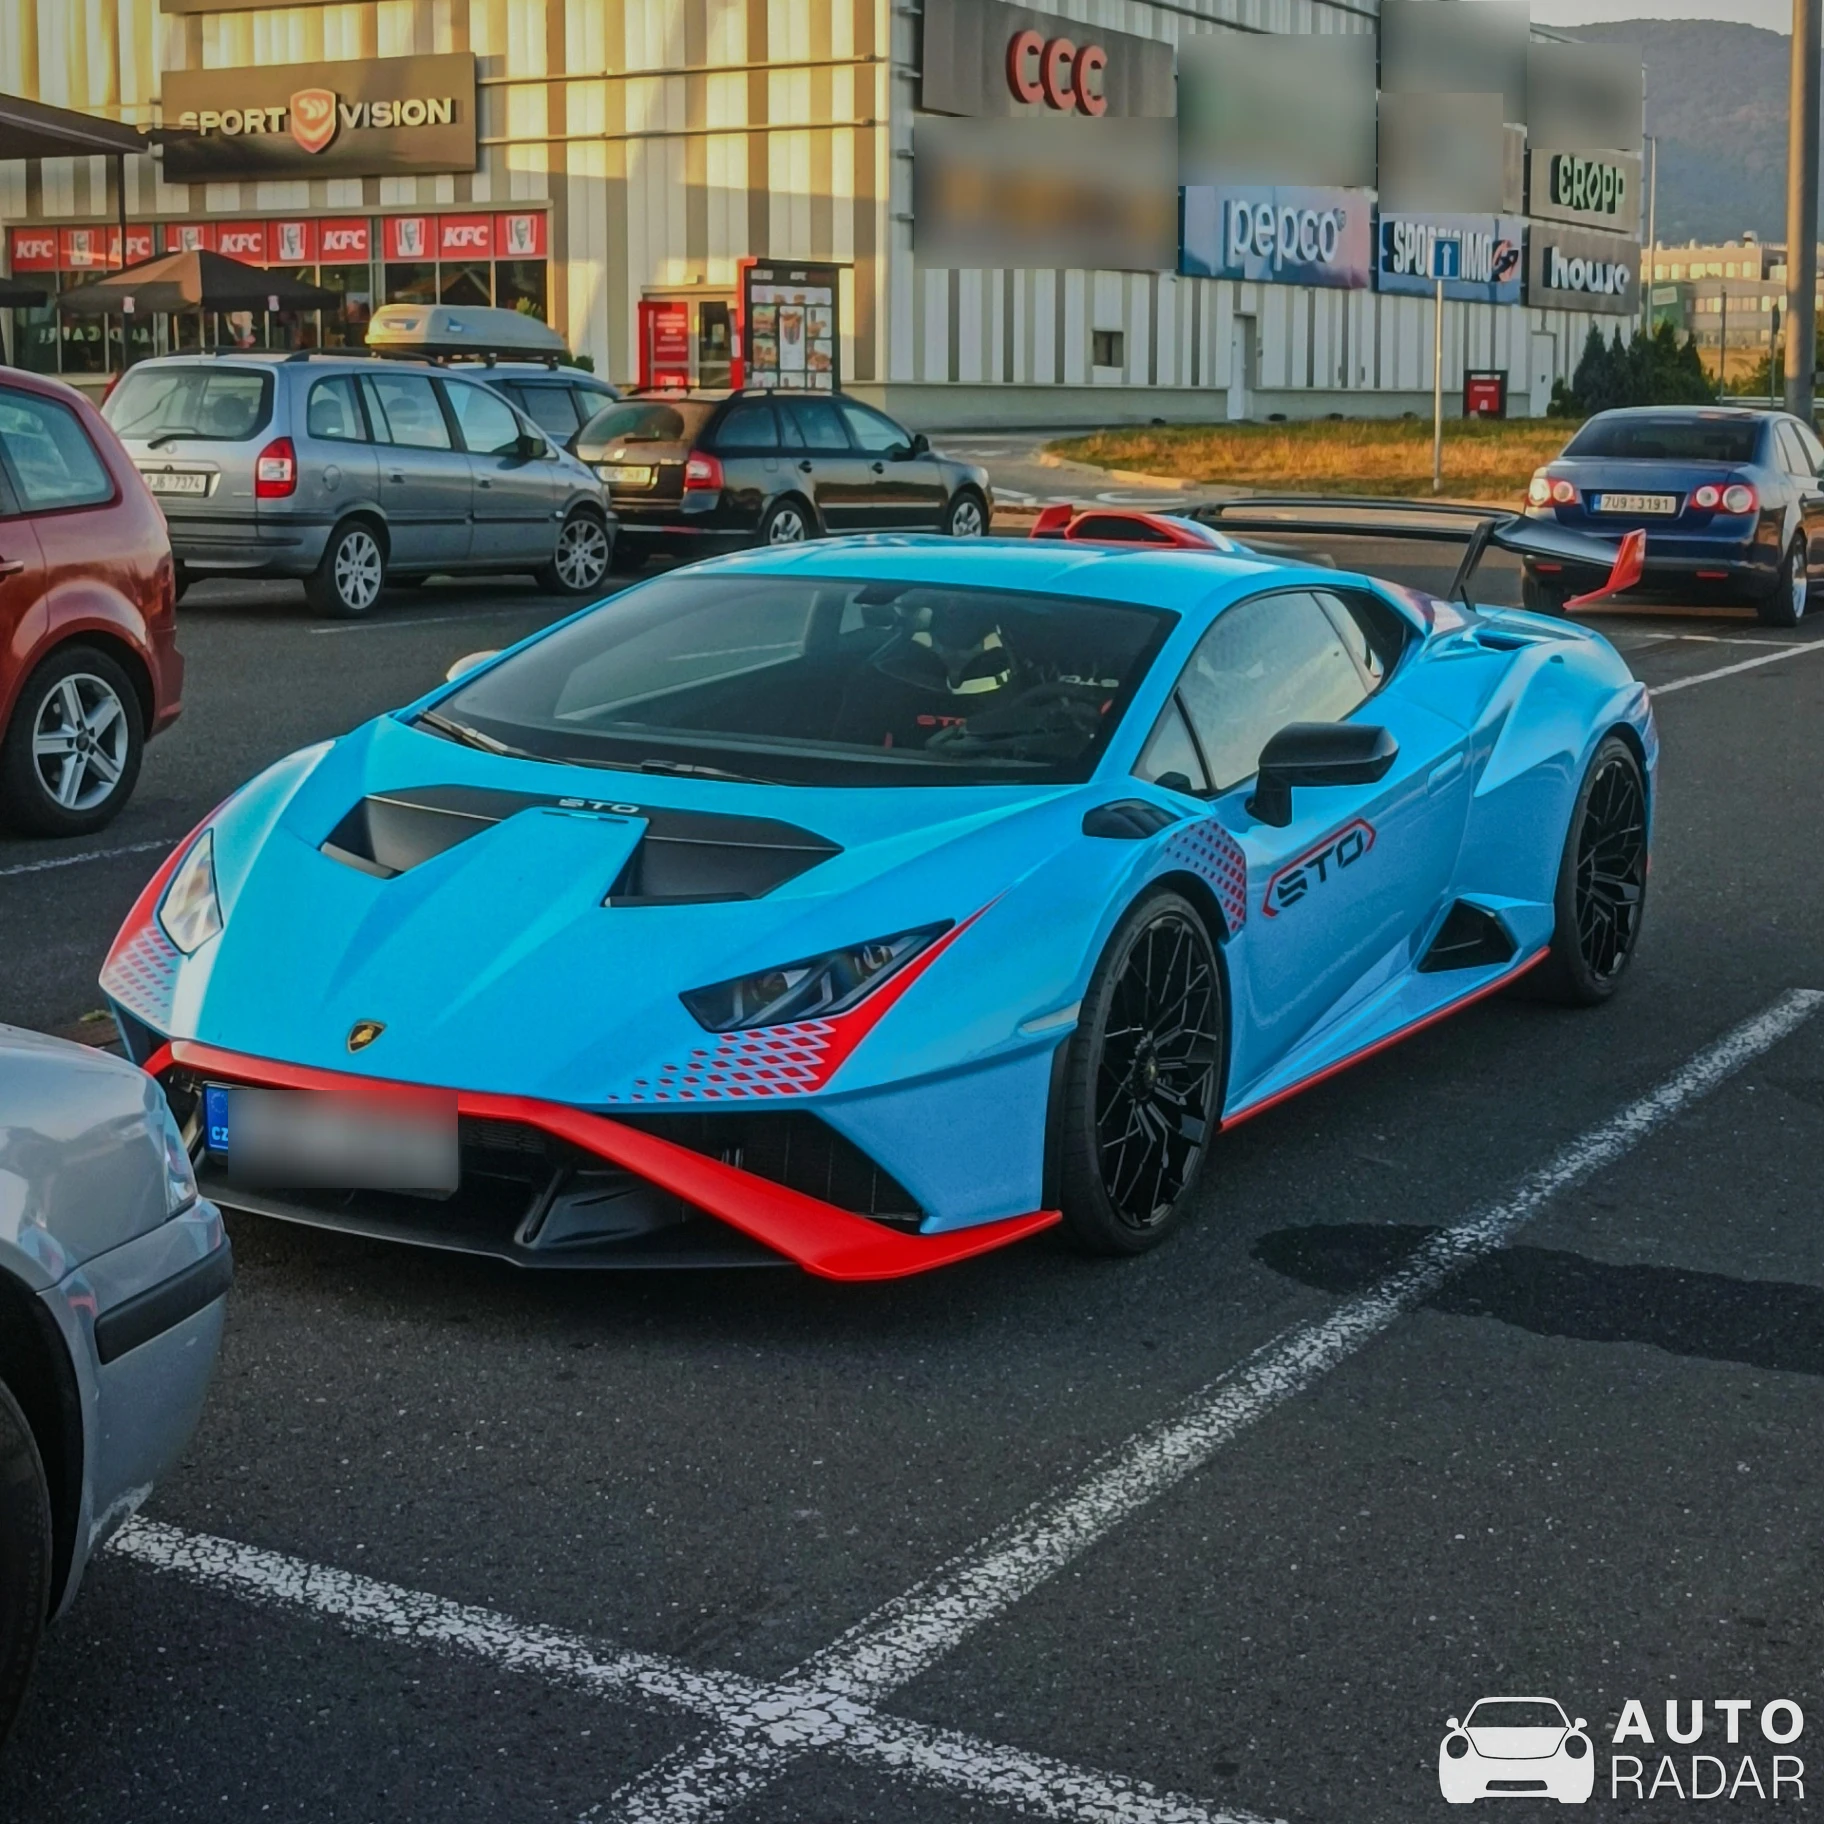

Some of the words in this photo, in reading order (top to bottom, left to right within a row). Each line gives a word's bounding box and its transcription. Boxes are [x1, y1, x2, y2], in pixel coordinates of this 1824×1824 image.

[1006, 29, 1107, 117] CCC
[339, 97, 452, 128] VISION
[1558, 155, 1626, 215] CROPP
[221, 233, 262, 253] KFC
[323, 229, 367, 251] KFC
[442, 225, 489, 247] KFC
[1227, 200, 1338, 271] pepco
[16, 239, 54, 259] KFC
[1550, 246, 1630, 295] house
[1604, 496, 1628, 509] 7U9
[1637, 497, 1668, 510] 3191
[559, 798, 640, 813] STO
[1277, 830, 1364, 908] STO
